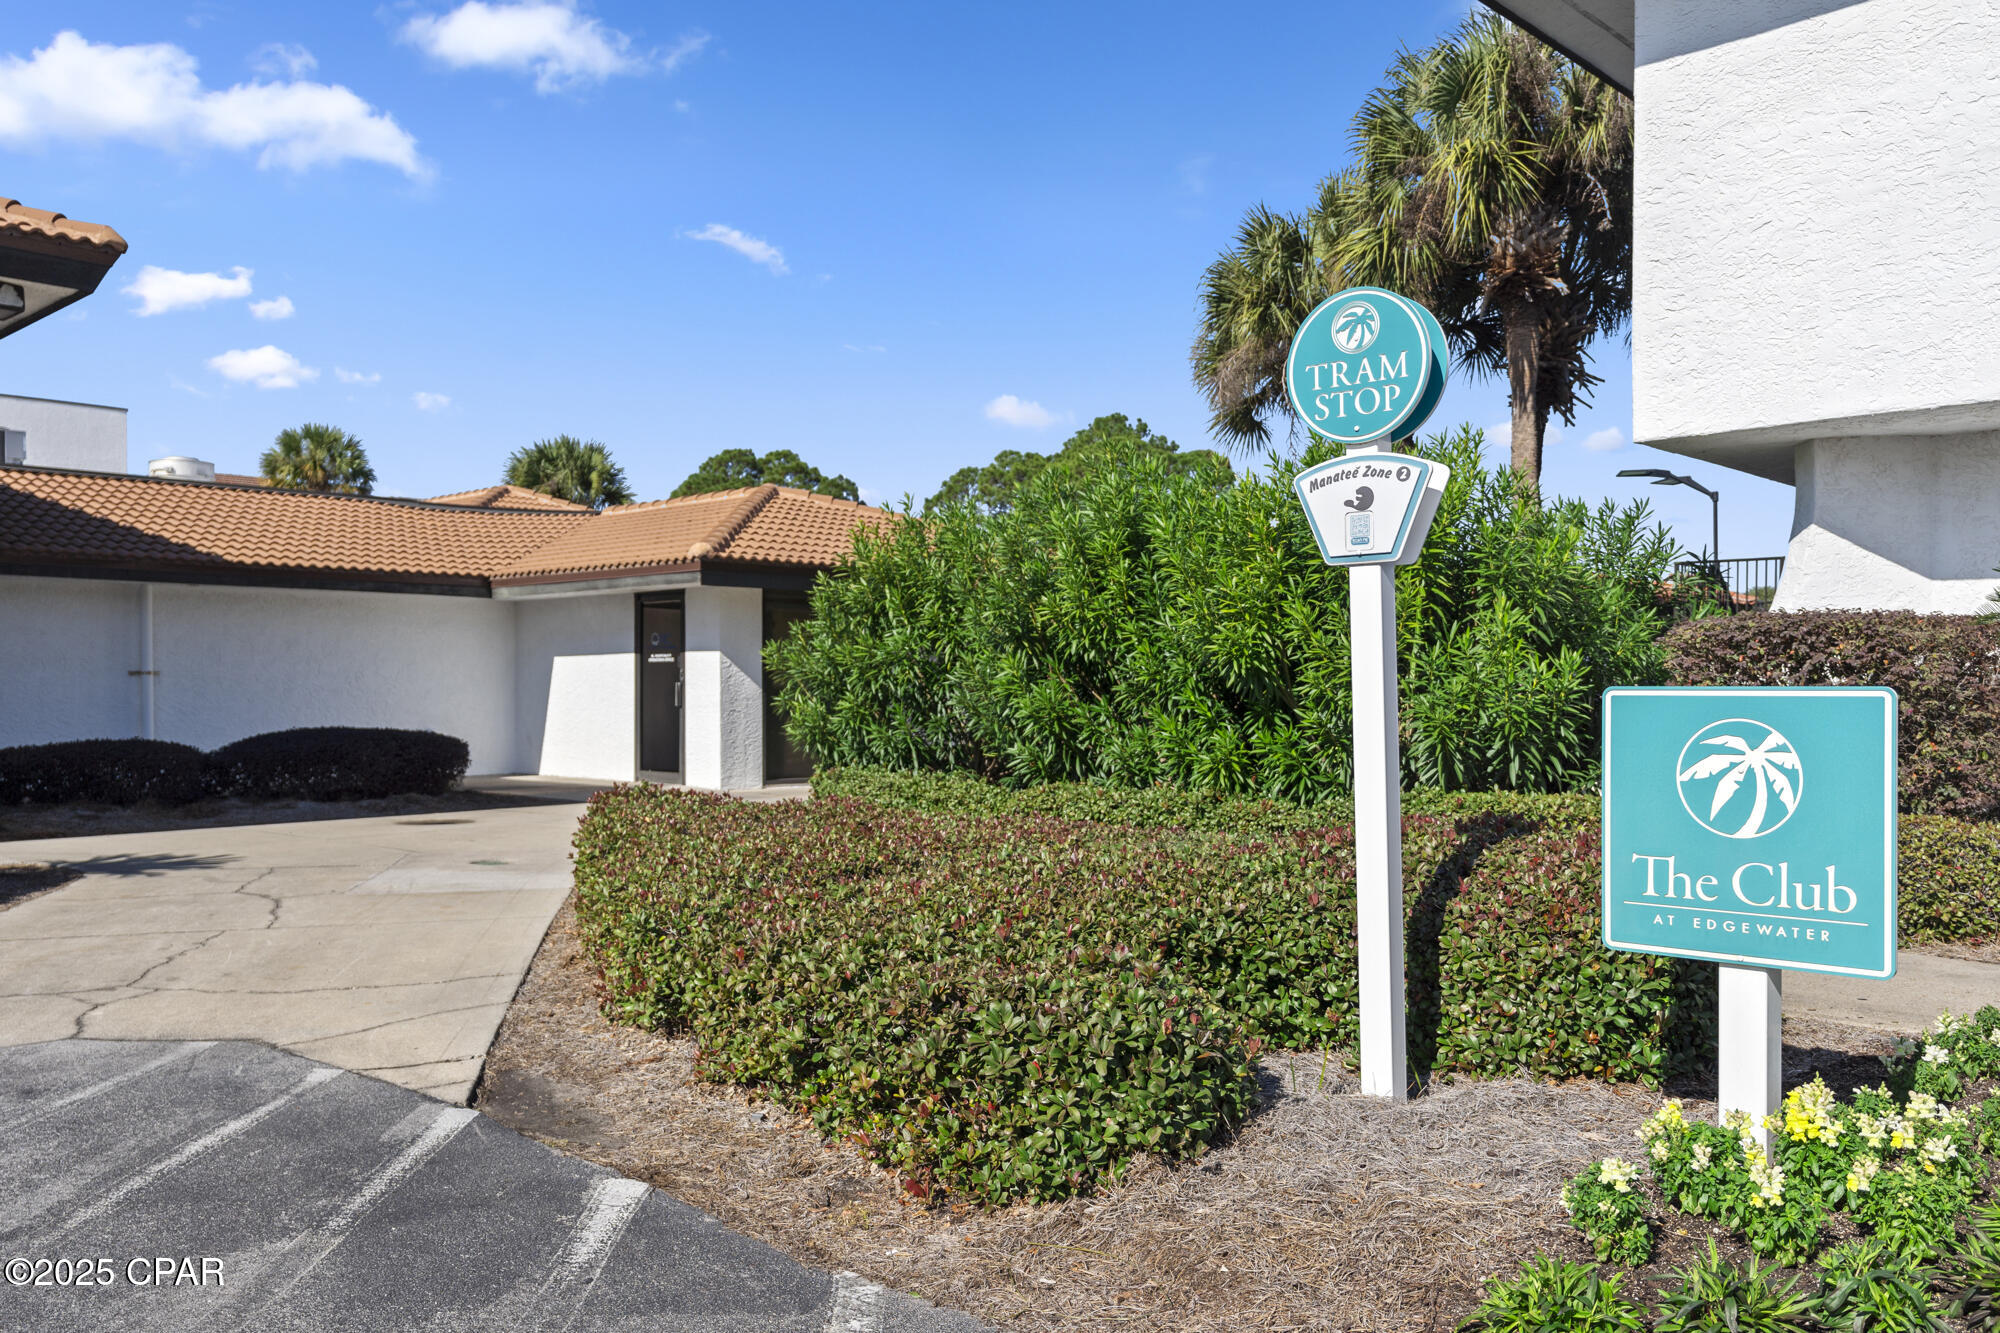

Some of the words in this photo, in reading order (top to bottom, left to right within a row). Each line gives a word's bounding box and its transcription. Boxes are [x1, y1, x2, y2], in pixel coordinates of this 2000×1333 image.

[1305, 350, 1408, 391] TRAM
[1314, 384, 1400, 421] STOP
[1362, 465, 1392, 478] Zone
[1398, 467, 1409, 481] 2
[1631, 853, 1719, 902] The
[1731, 862, 1858, 914] Club
[1653, 914, 1676, 926] AT
[1693, 917, 1831, 942] EDGEWATER
